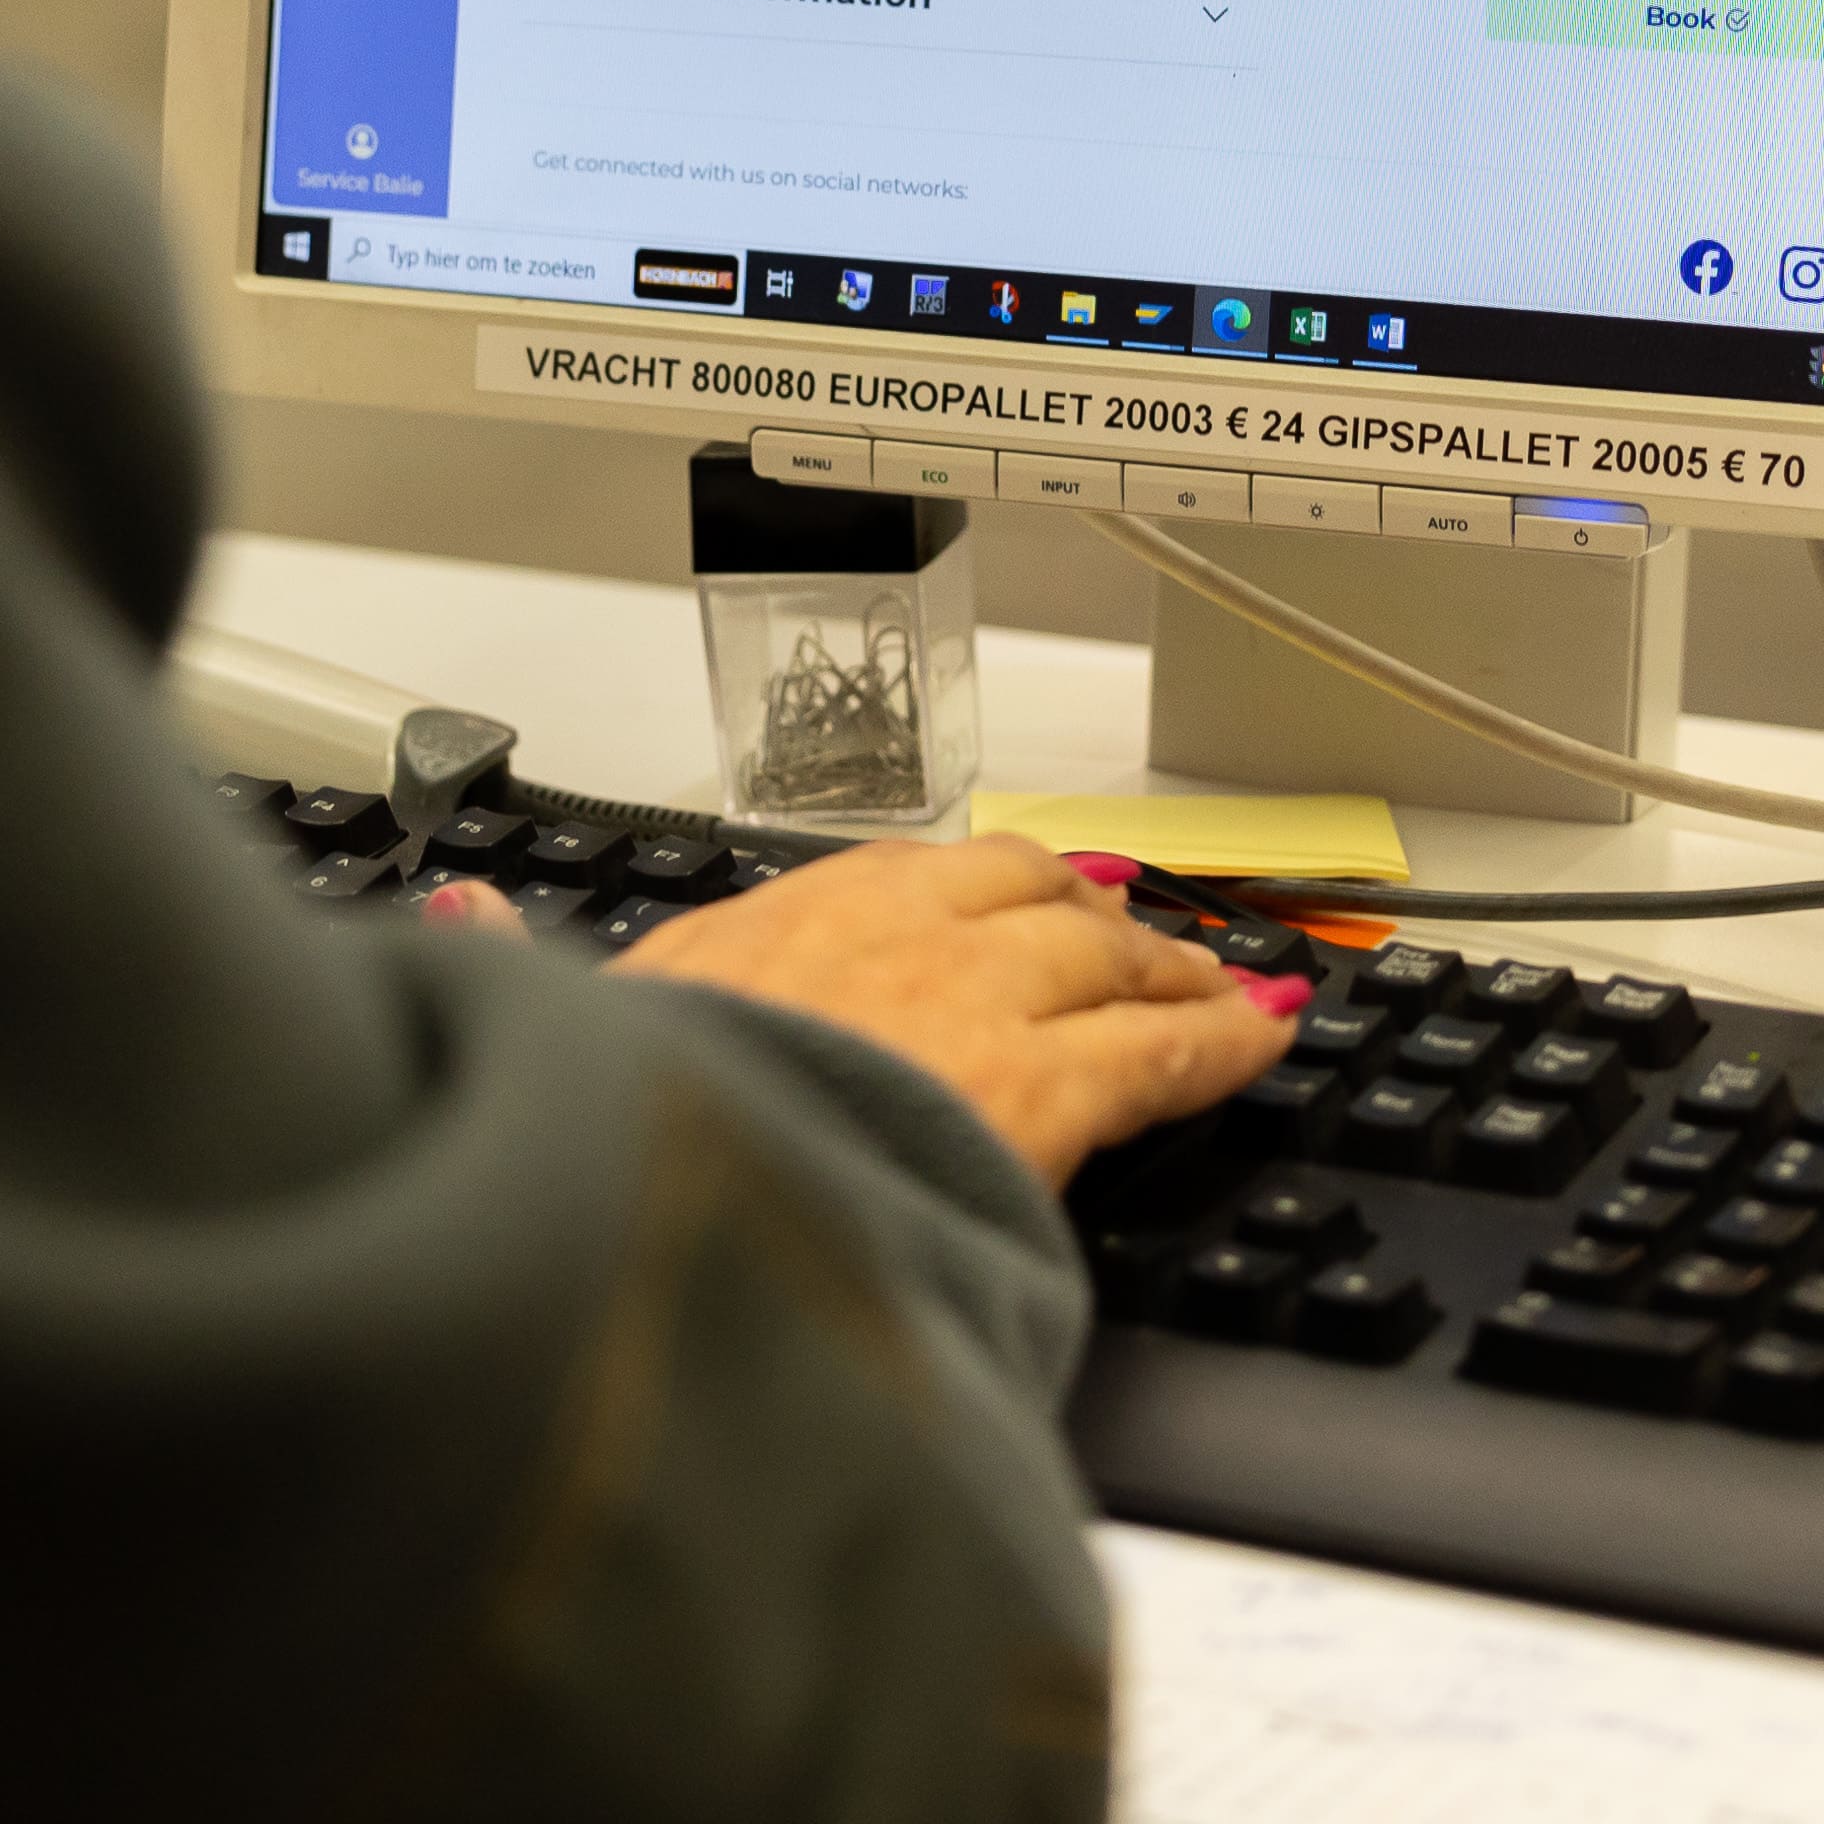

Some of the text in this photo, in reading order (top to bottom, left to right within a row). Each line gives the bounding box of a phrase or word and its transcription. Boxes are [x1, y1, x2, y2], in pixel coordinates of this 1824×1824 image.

[1646, 5, 1716, 30] Book
[526, 346, 1805, 488] VRACHT 800080 EUROPALLET 20003 € 24 GIPSPALLET 20005 € 70
[792, 455, 832, 471] MENU
[921, 469, 949, 484] ECO
[1041, 480, 1080, 495] INPUT
[1427, 516, 1469, 532] AUTO
[309, 797, 339, 815] F4
[455, 818, 485, 836] F5
[552, 832, 582, 850] F6
[653, 846, 683, 865] F7
